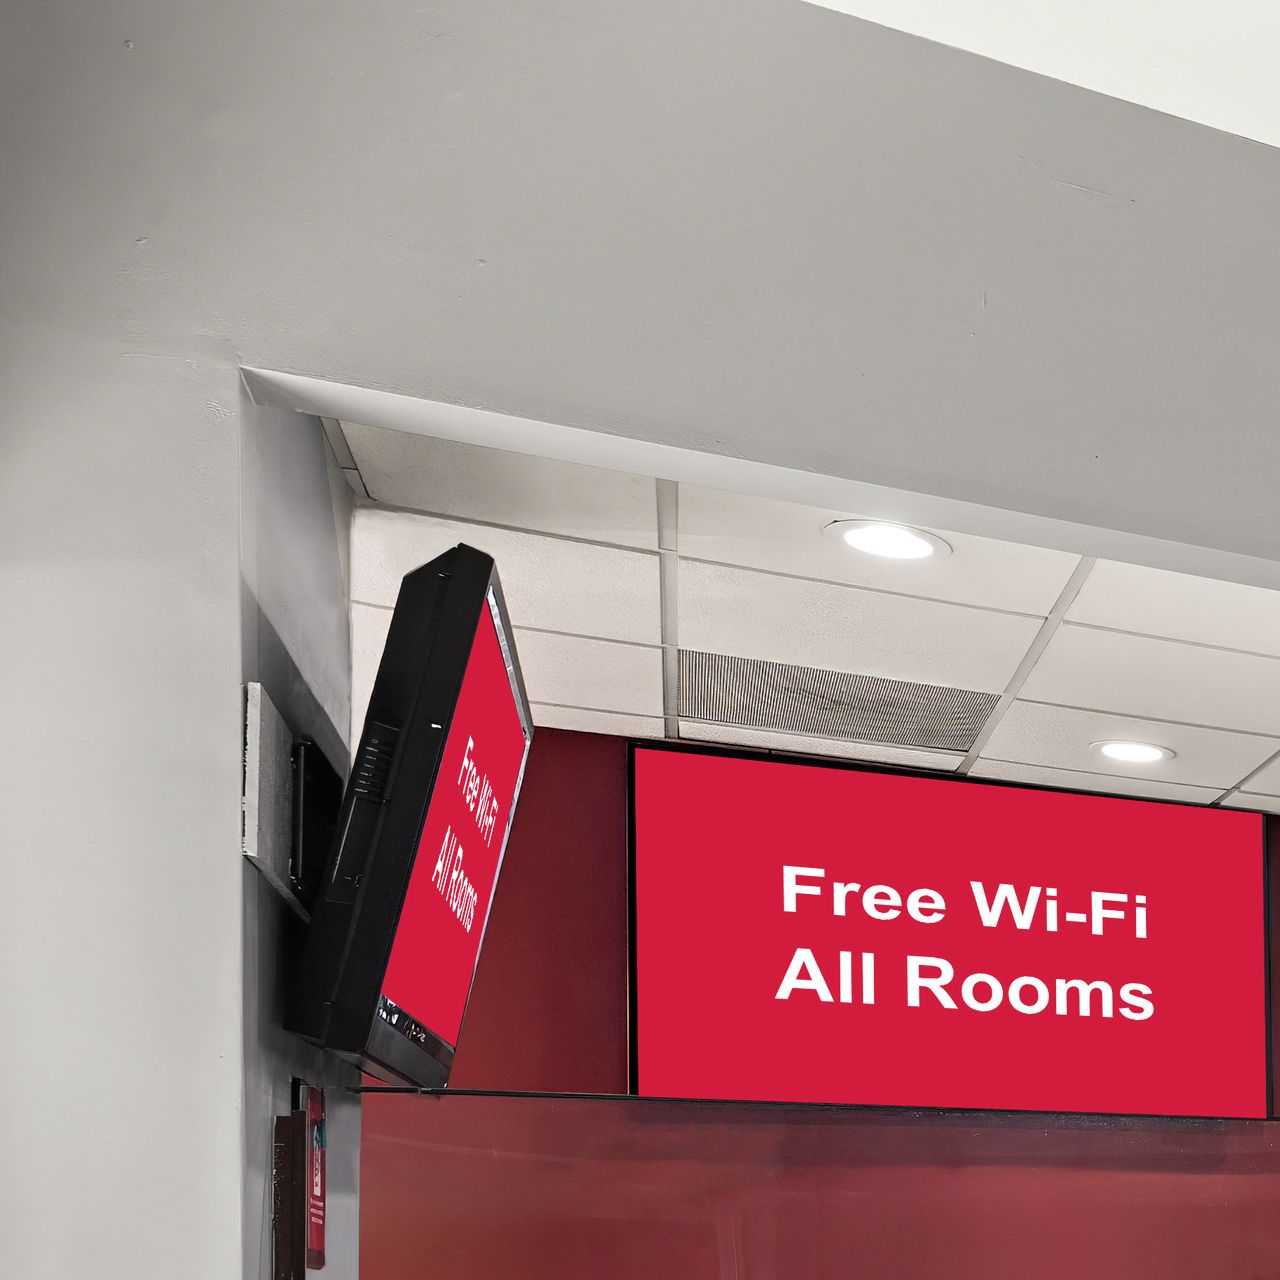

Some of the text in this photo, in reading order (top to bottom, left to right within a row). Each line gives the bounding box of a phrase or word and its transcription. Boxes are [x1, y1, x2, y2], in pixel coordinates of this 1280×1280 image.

[457, 735, 499, 848] Free Wi-Fi
[431, 824, 478, 933] All Rooms
[782, 865, 1149, 939] Free Wi-Fi
[774, 947, 1156, 1021] All Rooms
